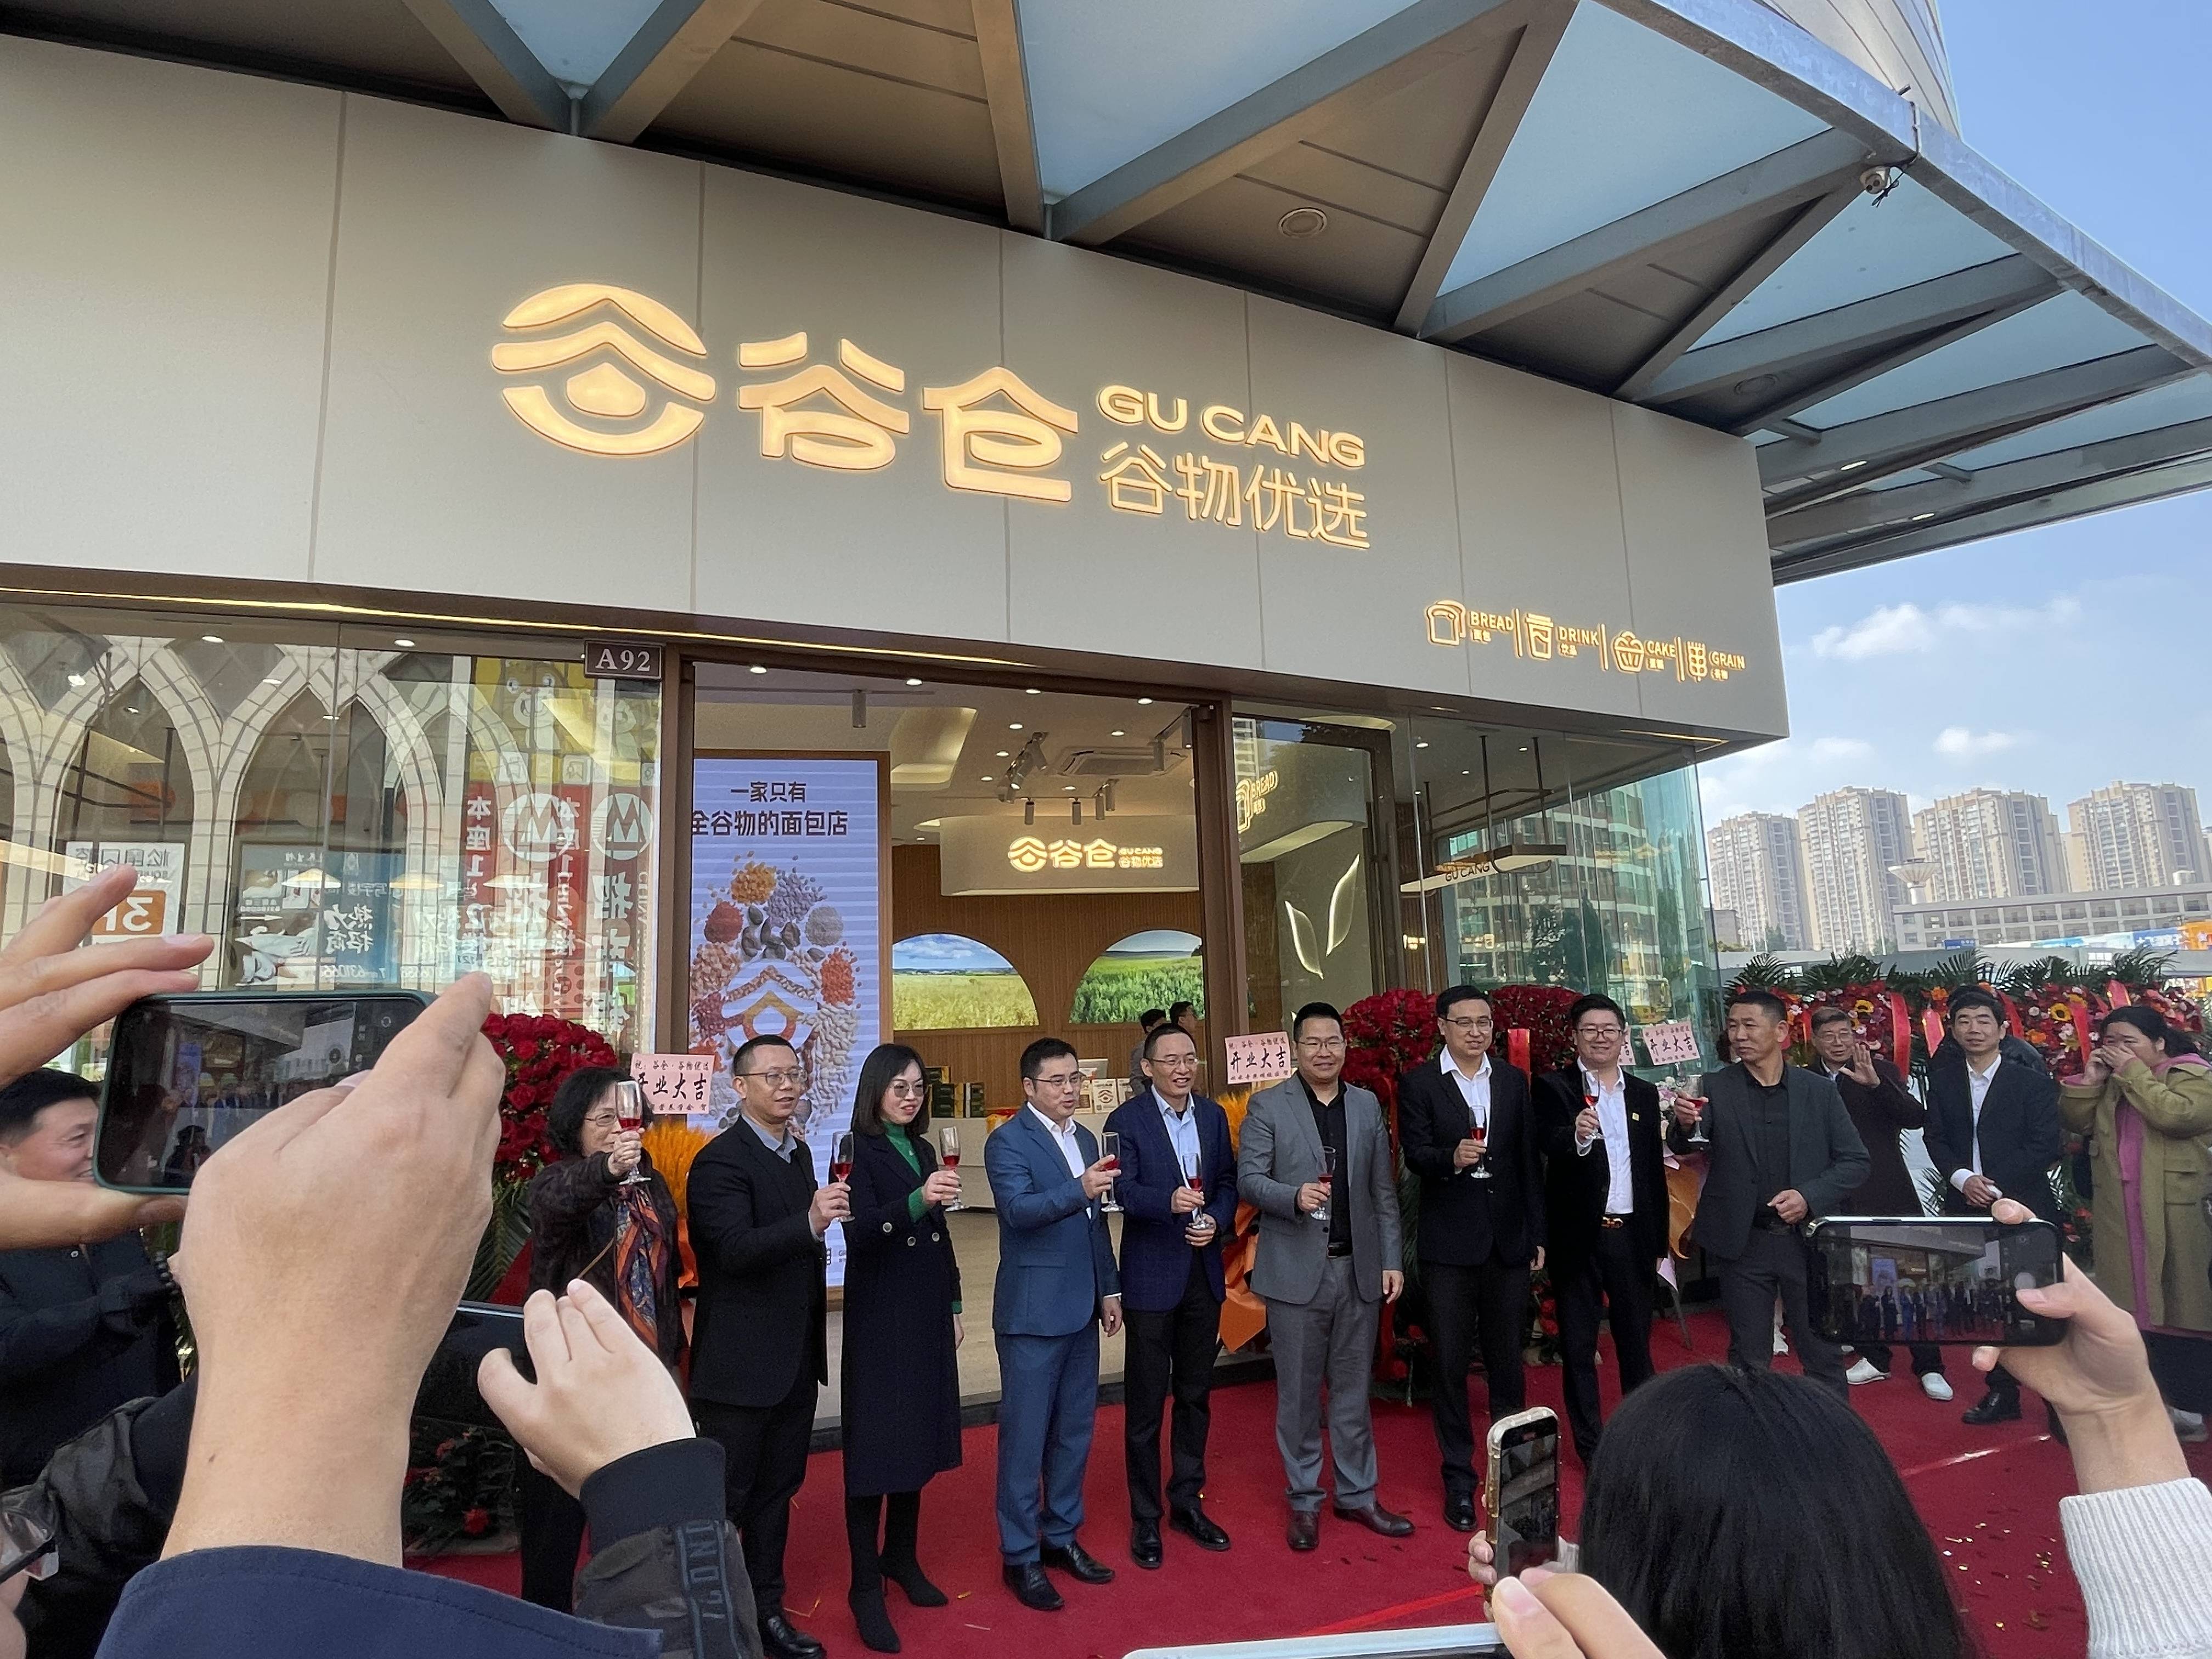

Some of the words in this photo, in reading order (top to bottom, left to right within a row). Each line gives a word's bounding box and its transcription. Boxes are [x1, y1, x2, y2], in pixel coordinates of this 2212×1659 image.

[737, 331, 1079, 503] 谷仓
[1098, 384, 1188, 432] GU
[1201, 405, 1366, 469] CANG
[1099, 441, 1370, 550] 谷物优选
[1469, 610, 1514, 632] BREAD
[1557, 625, 1600, 646] DRINK
[595, 648, 651, 672] A92
[1645, 640, 1677, 659] CAKE
[1709, 650, 1746, 670] GRAIN
[730, 781, 806, 803] 一家只有
[1251, 770, 1278, 800] BREAD
[692, 810, 848, 837] 全谷物的面包店
[1048, 838, 1118, 869] 谷仓
[1445, 871, 1459, 882] GU
[1463, 861, 1491, 878] CANG
[1649, 1032, 1694, 1057] 开业大吉
[1230, 1046, 1286, 1074] 开业大吉
